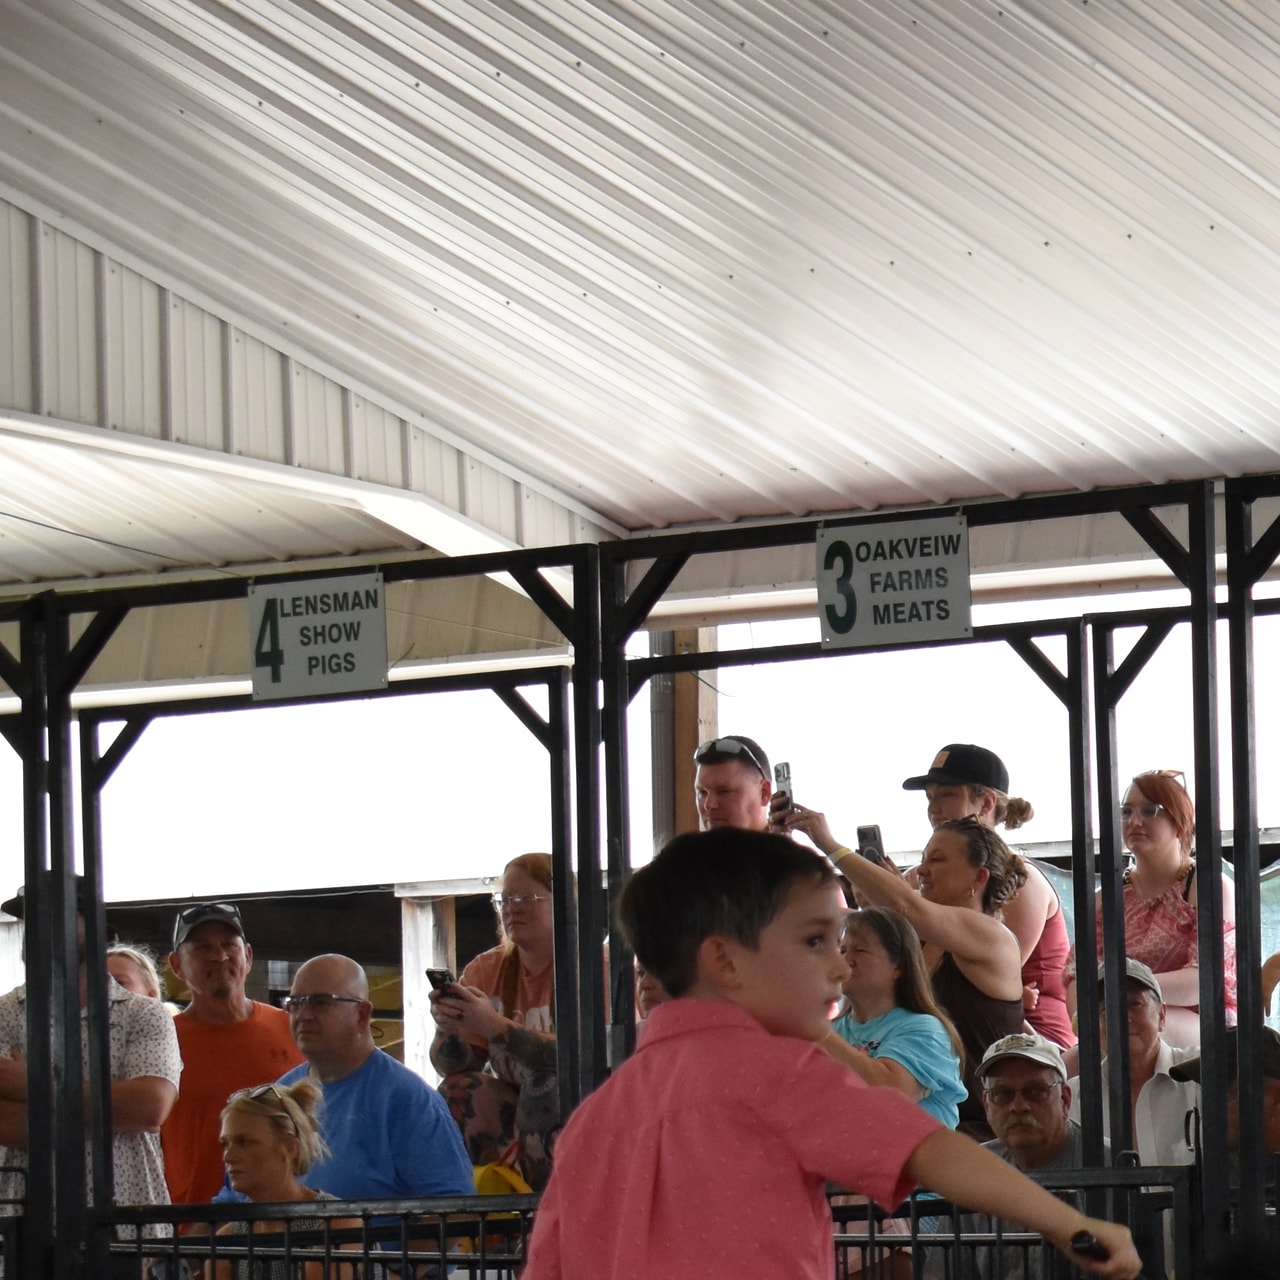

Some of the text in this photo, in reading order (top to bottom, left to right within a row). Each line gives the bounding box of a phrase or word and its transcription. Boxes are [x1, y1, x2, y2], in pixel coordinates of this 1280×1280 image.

[855, 533, 962, 563] OAKVEIW
[824, 540, 857, 635] 3
[870, 567, 949, 593] FARMS
[280, 589, 379, 618] LENSMAN
[872, 599, 950, 625] MEATS
[255, 598, 284, 683] 4
[300, 621, 361, 646] SHOW
[308, 652, 356, 676] PIGS
